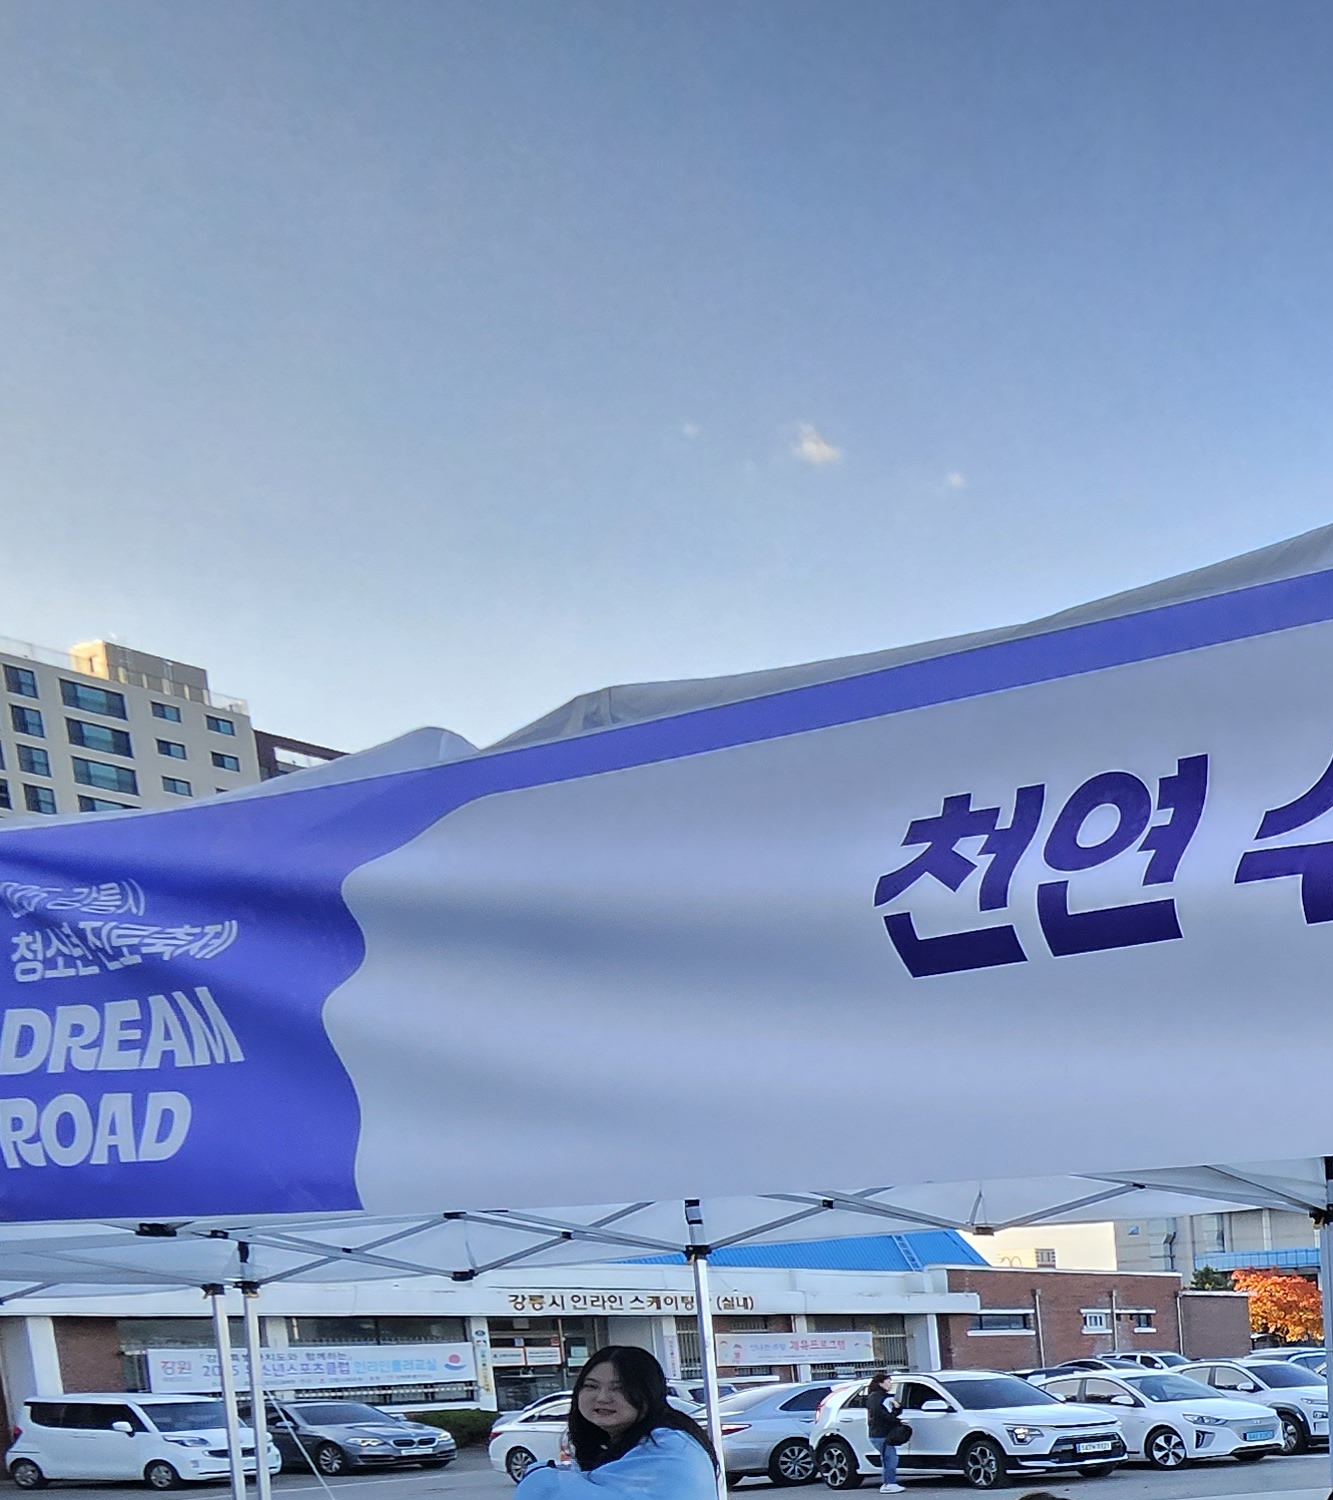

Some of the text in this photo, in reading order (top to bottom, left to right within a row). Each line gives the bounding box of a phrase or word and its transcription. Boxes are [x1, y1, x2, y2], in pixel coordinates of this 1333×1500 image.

[872, 753, 1210, 979] 천연
[0, 987, 245, 1076] DREAM
[0, 1091, 192, 1169] ROAD
[508, 1294, 755, 1312] 강릉시 인라인 스케이팅 (실내)
[202, 1364, 240, 1377] 205
[246, 1361, 350, 1377] 소년스포츠클럽
